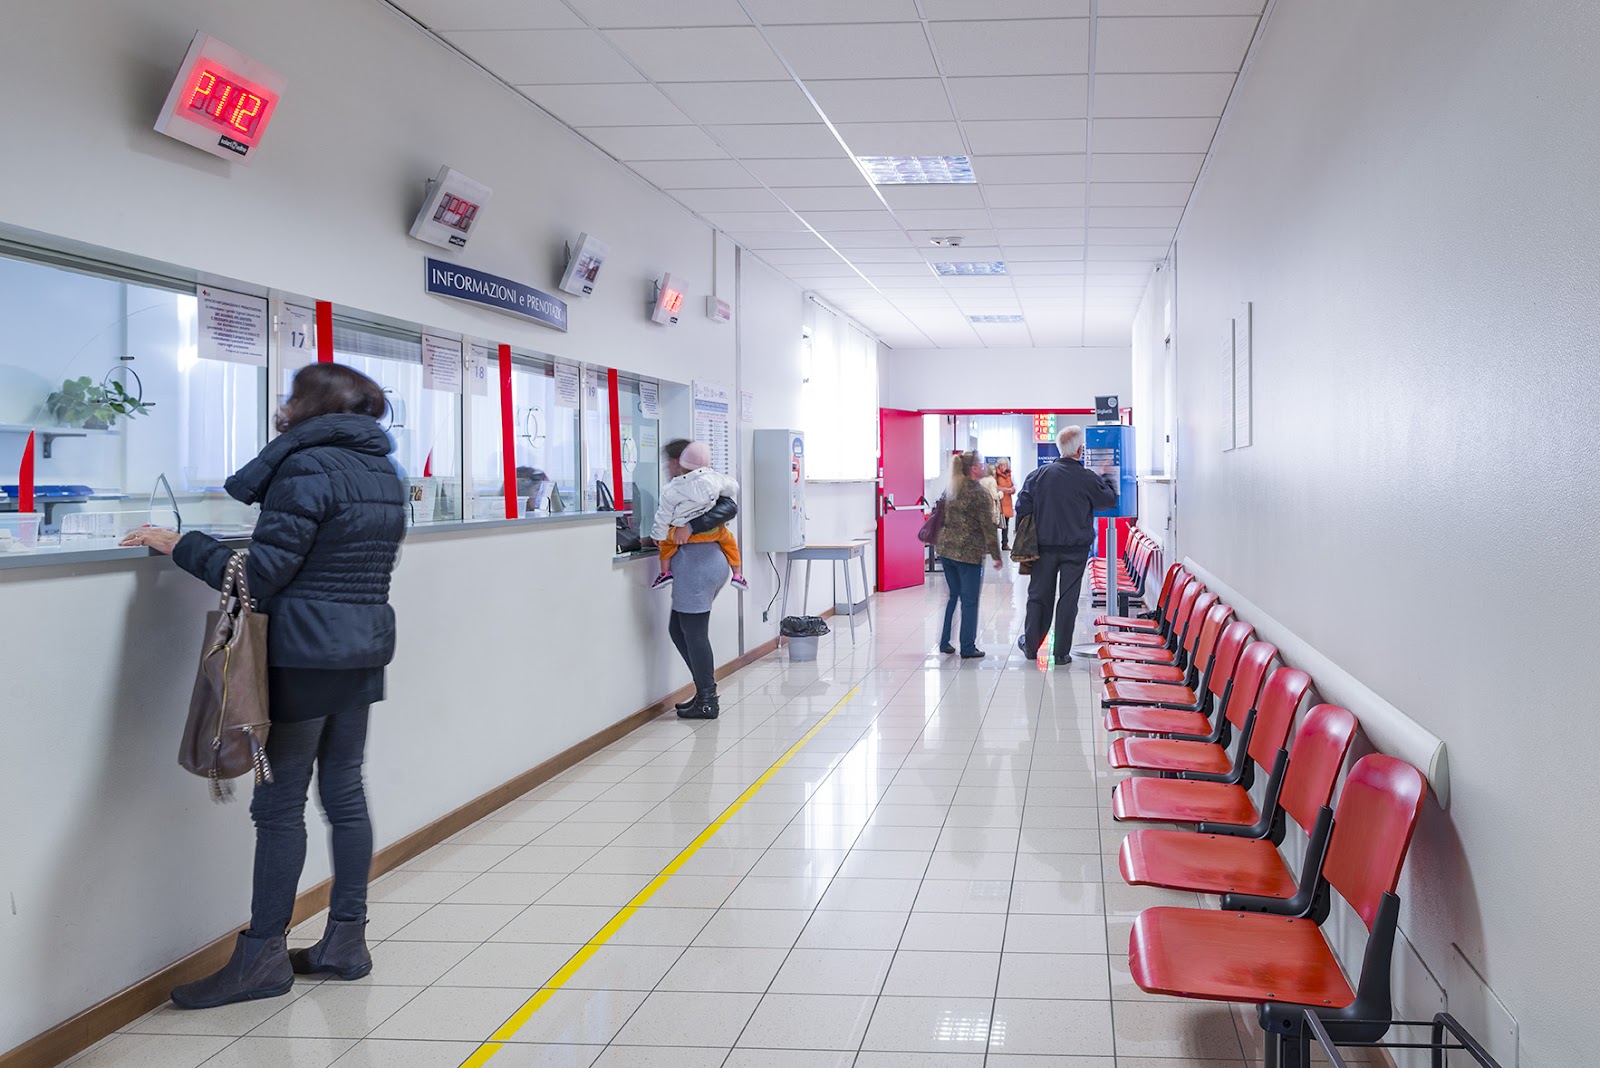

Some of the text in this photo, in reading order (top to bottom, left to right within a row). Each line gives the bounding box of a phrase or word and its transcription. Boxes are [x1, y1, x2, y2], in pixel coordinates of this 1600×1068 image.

[432, 268, 517, 304] INFORMAZIONI
[519, 295, 525, 306] e
[291, 331, 305, 348] 17
[475, 366, 485, 379] 18
[588, 386, 596, 397] 19
